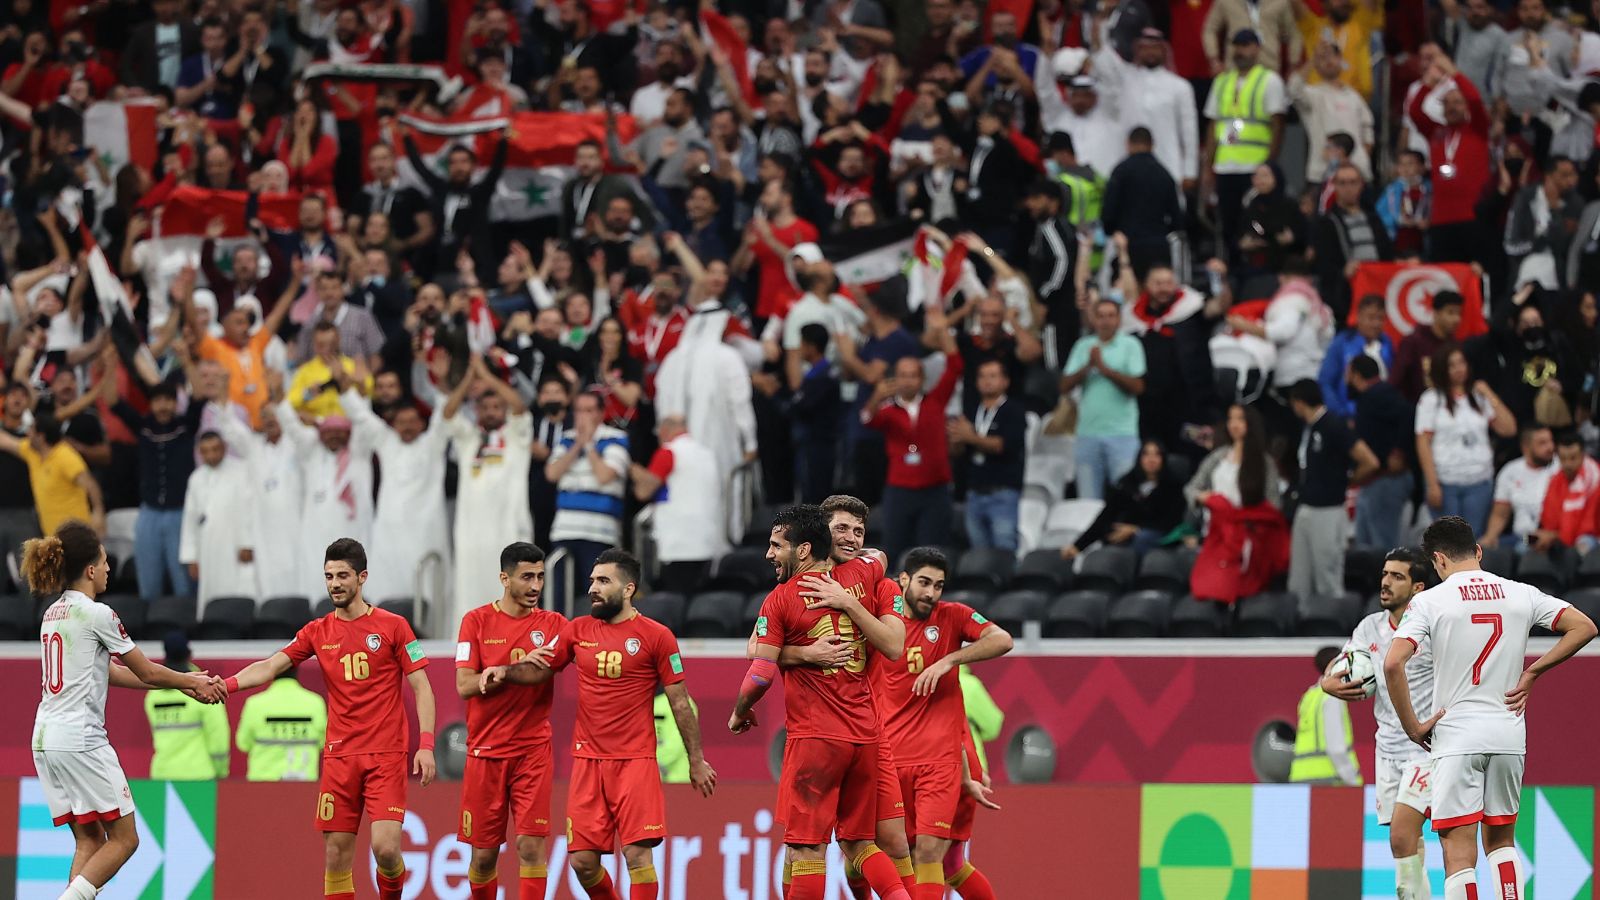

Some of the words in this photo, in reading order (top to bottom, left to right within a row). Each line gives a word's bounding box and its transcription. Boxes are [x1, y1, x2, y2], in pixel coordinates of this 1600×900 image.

[1458, 584, 1505, 601] MSEKNI
[42, 632, 63, 694] 10
[595, 650, 623, 678] 18
[906, 646, 924, 673] 5
[1471, 613, 1503, 685] 7
[339, 651, 370, 681] 16
[316, 791, 335, 821] 6
[462, 810, 472, 838] 9
[369, 809, 508, 900] Ge
